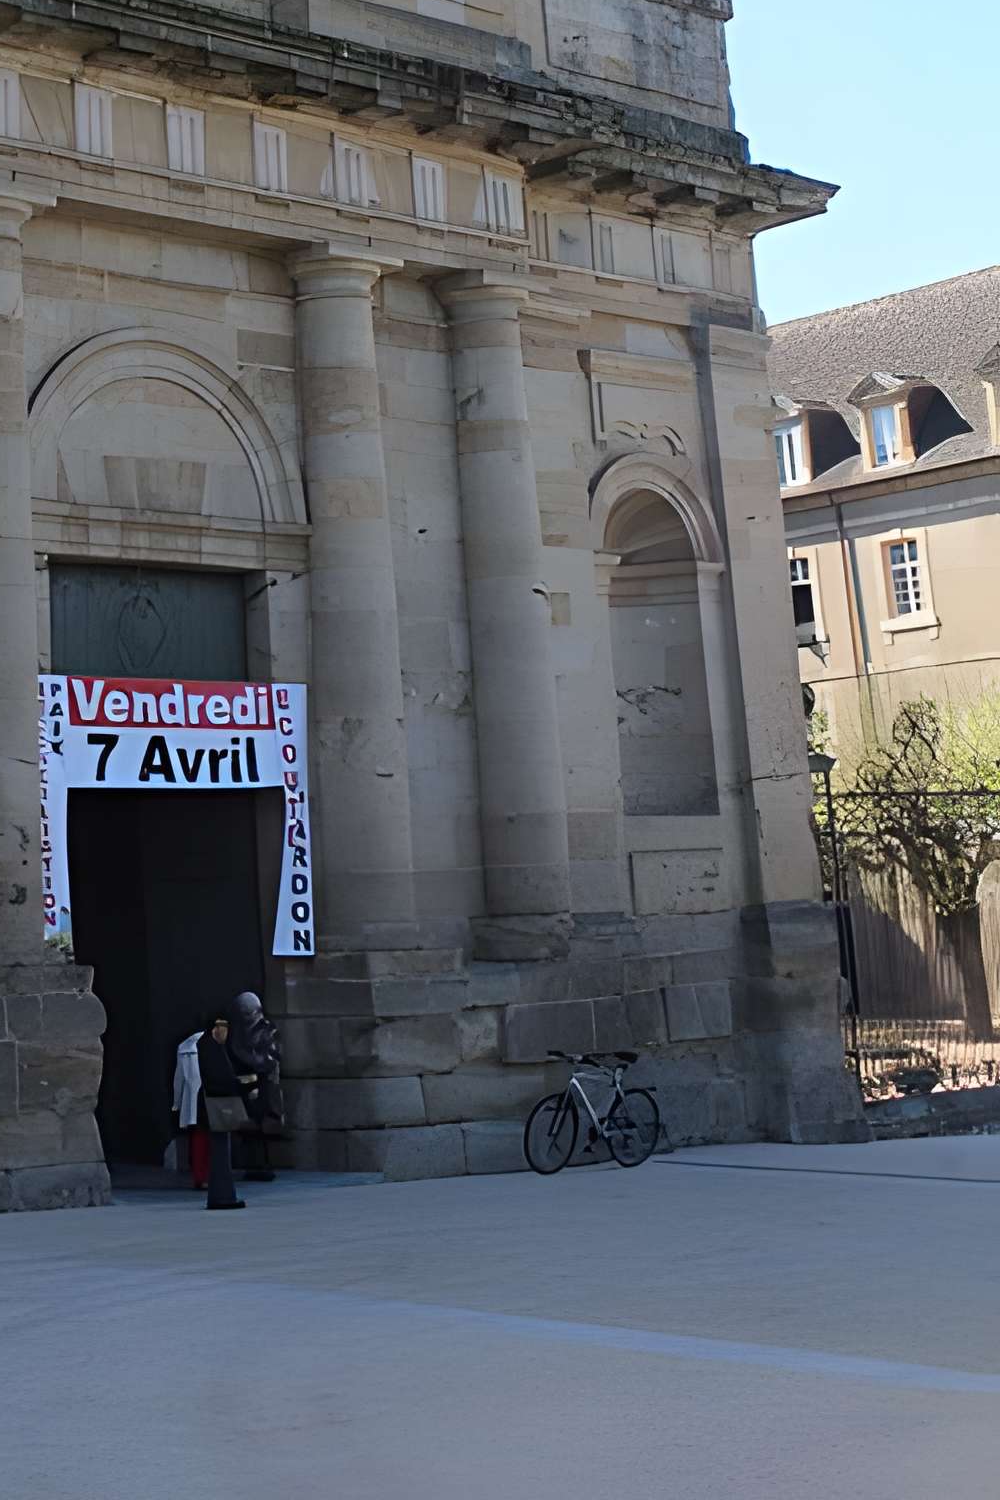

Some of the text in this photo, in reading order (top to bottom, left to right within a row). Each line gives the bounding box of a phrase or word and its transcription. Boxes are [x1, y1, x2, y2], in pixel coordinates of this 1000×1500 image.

[71, 679, 269, 726] Vendredi
[87, 733, 260, 783] 7 Avril
